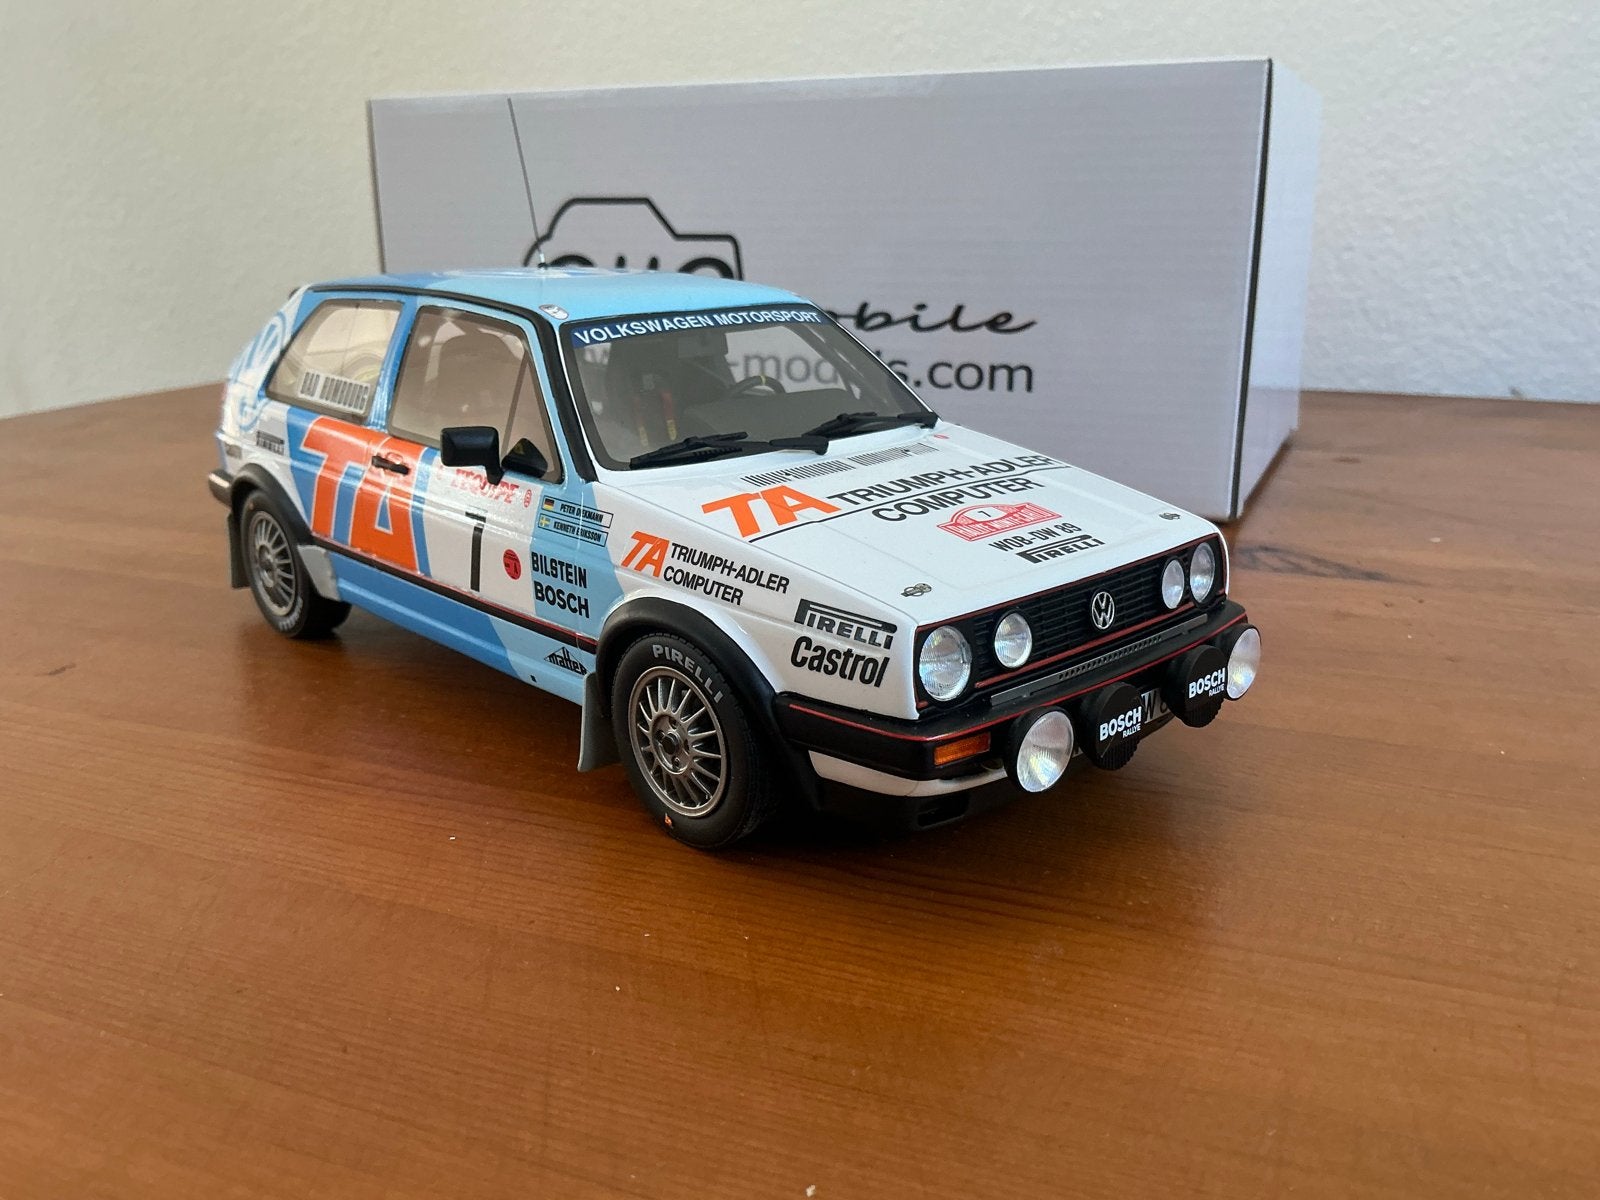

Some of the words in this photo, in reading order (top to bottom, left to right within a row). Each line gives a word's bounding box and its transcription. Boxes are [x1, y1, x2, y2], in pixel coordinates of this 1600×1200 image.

[574, 314, 714, 345] VOLKSWAGEN
[712, 310, 822, 326] MOTORSPORT
[825, 301, 1037, 334] bile
[302, 415, 427, 574] TA
[826, 454, 1064, 506] TRIUMPH-ADLER
[559, 503, 576, 517] PETER
[576, 507, 604, 523] DEKMANN
[701, 484, 842, 538] TA
[871, 477, 1046, 522] COMPUTER
[553, 521, 577, 536] KENNETH
[988, 527, 1062, 552] WOB-DW
[1053, 522, 1083, 534] 89
[621, 530, 670, 578] TA
[671, 542, 790, 594] TRIUMPH-ADLER
[1015, 534, 1106, 564] PIRELLI
[531, 551, 588, 589] BILSTEIN
[663, 565, 744, 606] COMPUTER
[533, 580, 590, 619] BOSCH
[794, 598, 898, 650] PIRELLI
[652, 644, 724, 704] PIRELLI
[790, 635, 890, 688] Castrol
[1188, 667, 1226, 699] BOSCH
[1208, 684, 1226, 697] RALLYE
[1099, 705, 1142, 742] BOSCH
[1122, 722, 1142, 738] RALLYE
